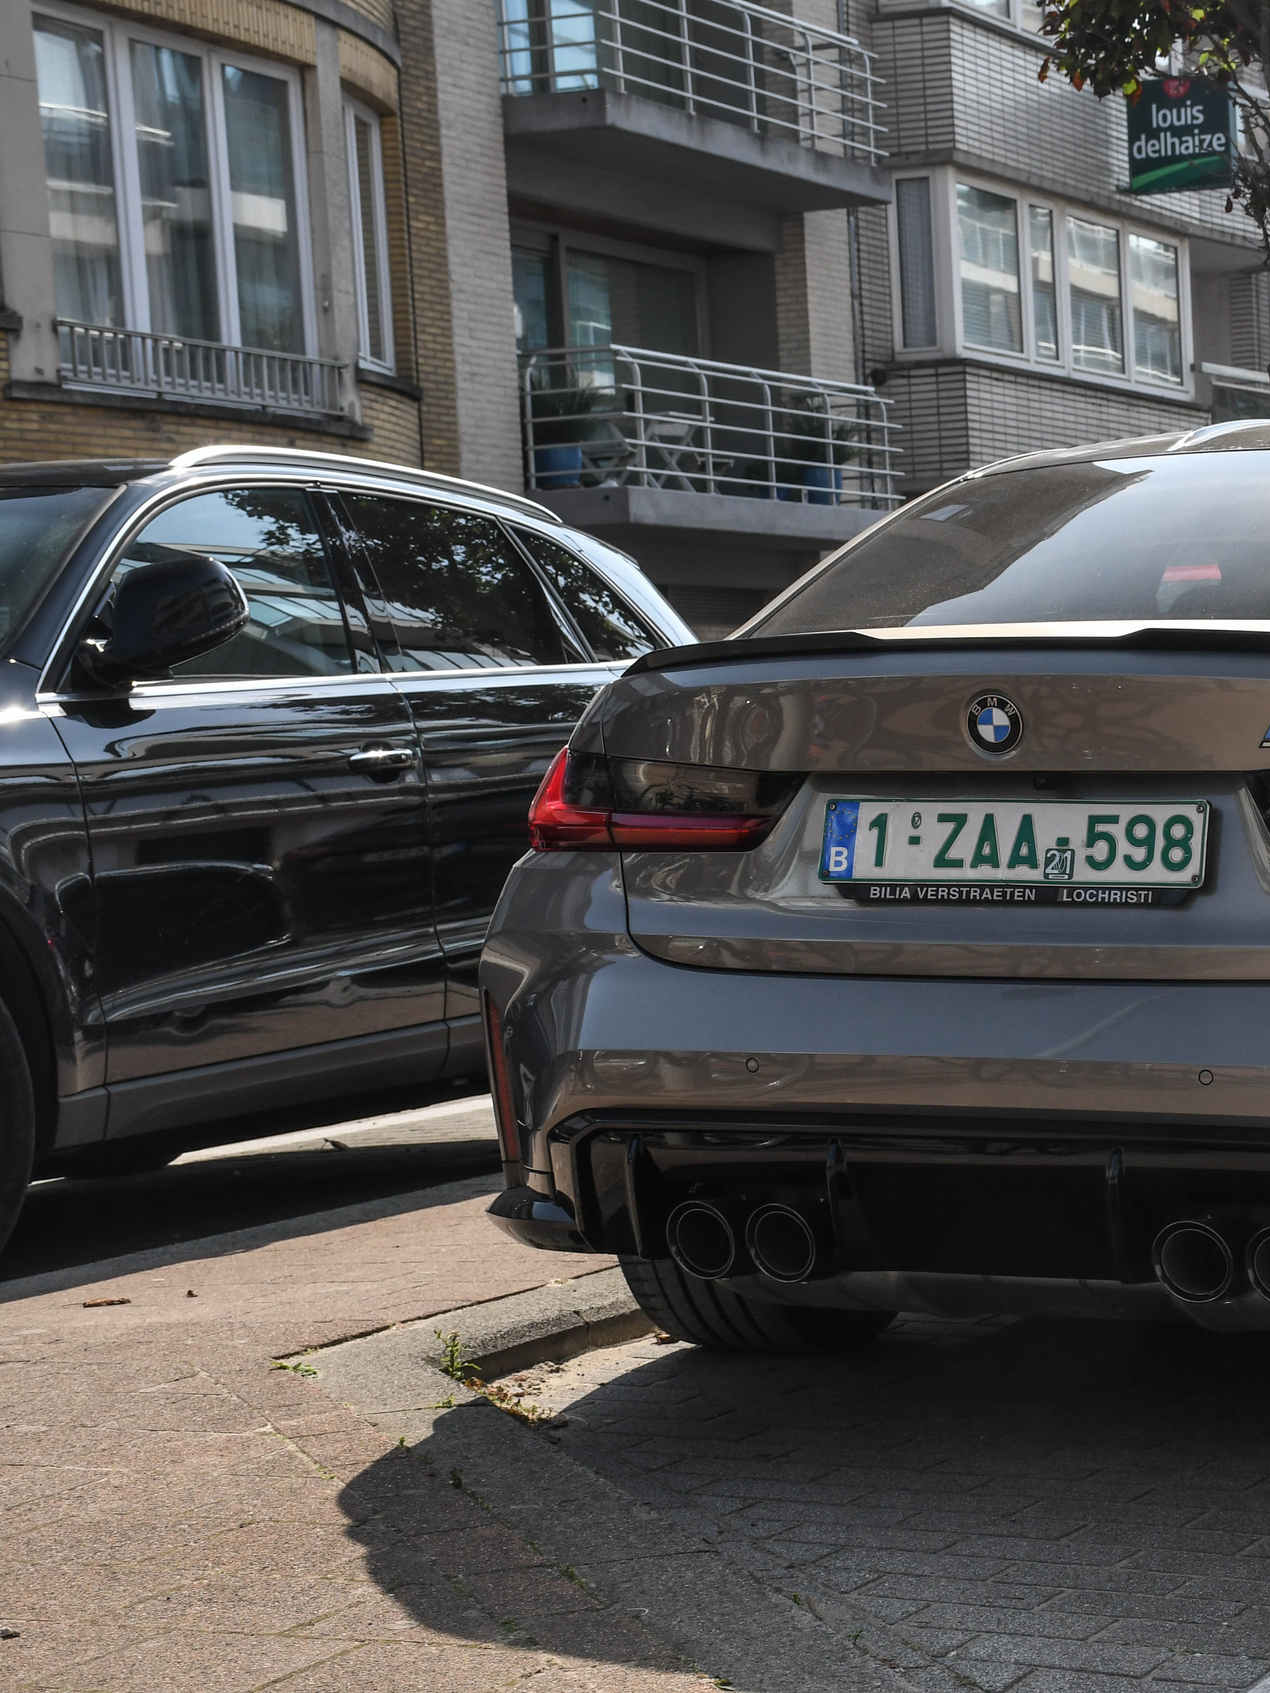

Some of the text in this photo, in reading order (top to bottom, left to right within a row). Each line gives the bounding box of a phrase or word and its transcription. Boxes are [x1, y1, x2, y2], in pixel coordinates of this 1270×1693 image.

[1151, 100, 1204, 128] louis
[1132, 129, 1226, 159] delhaize
[971, 697, 1016, 716] BMW
[828, 846, 849, 872] B
[1044, 849, 1072, 874] 21
[869, 886, 1153, 903] BILIA VERSTRAETEN LOCHRISTI
